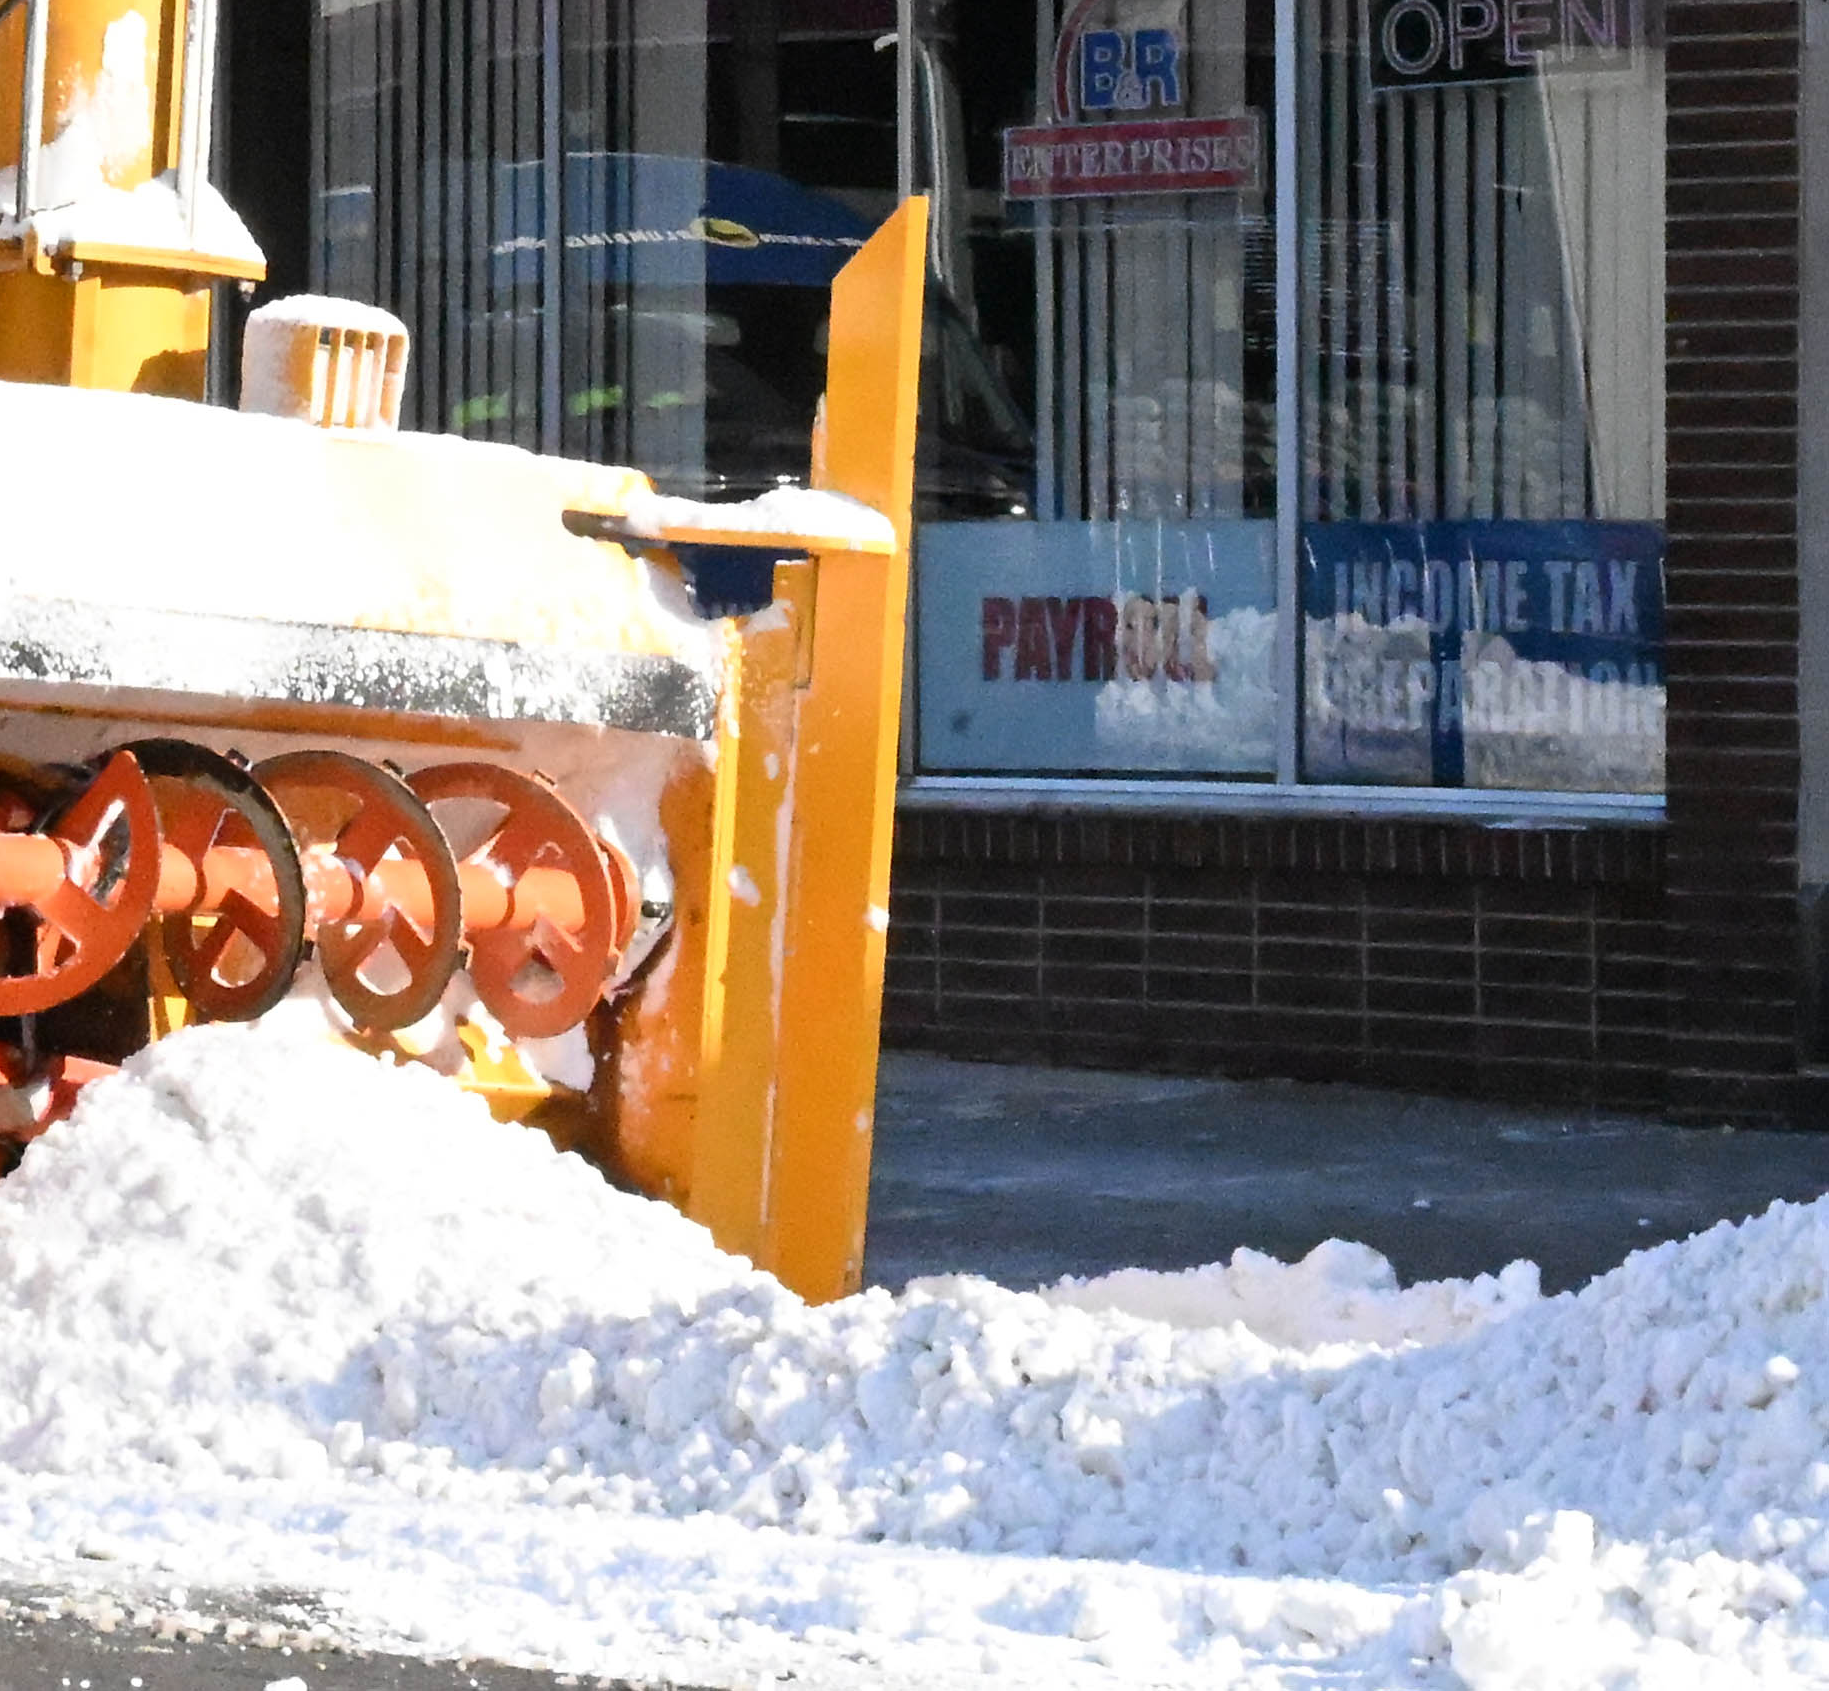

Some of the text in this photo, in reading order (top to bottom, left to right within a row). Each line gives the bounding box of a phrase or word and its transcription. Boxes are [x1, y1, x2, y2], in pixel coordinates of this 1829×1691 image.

[1081, 29, 1181, 109] B&R
[1010, 136, 1250, 179] ENTERPRISES
[1334, 560, 1639, 633] INCOME TAX
